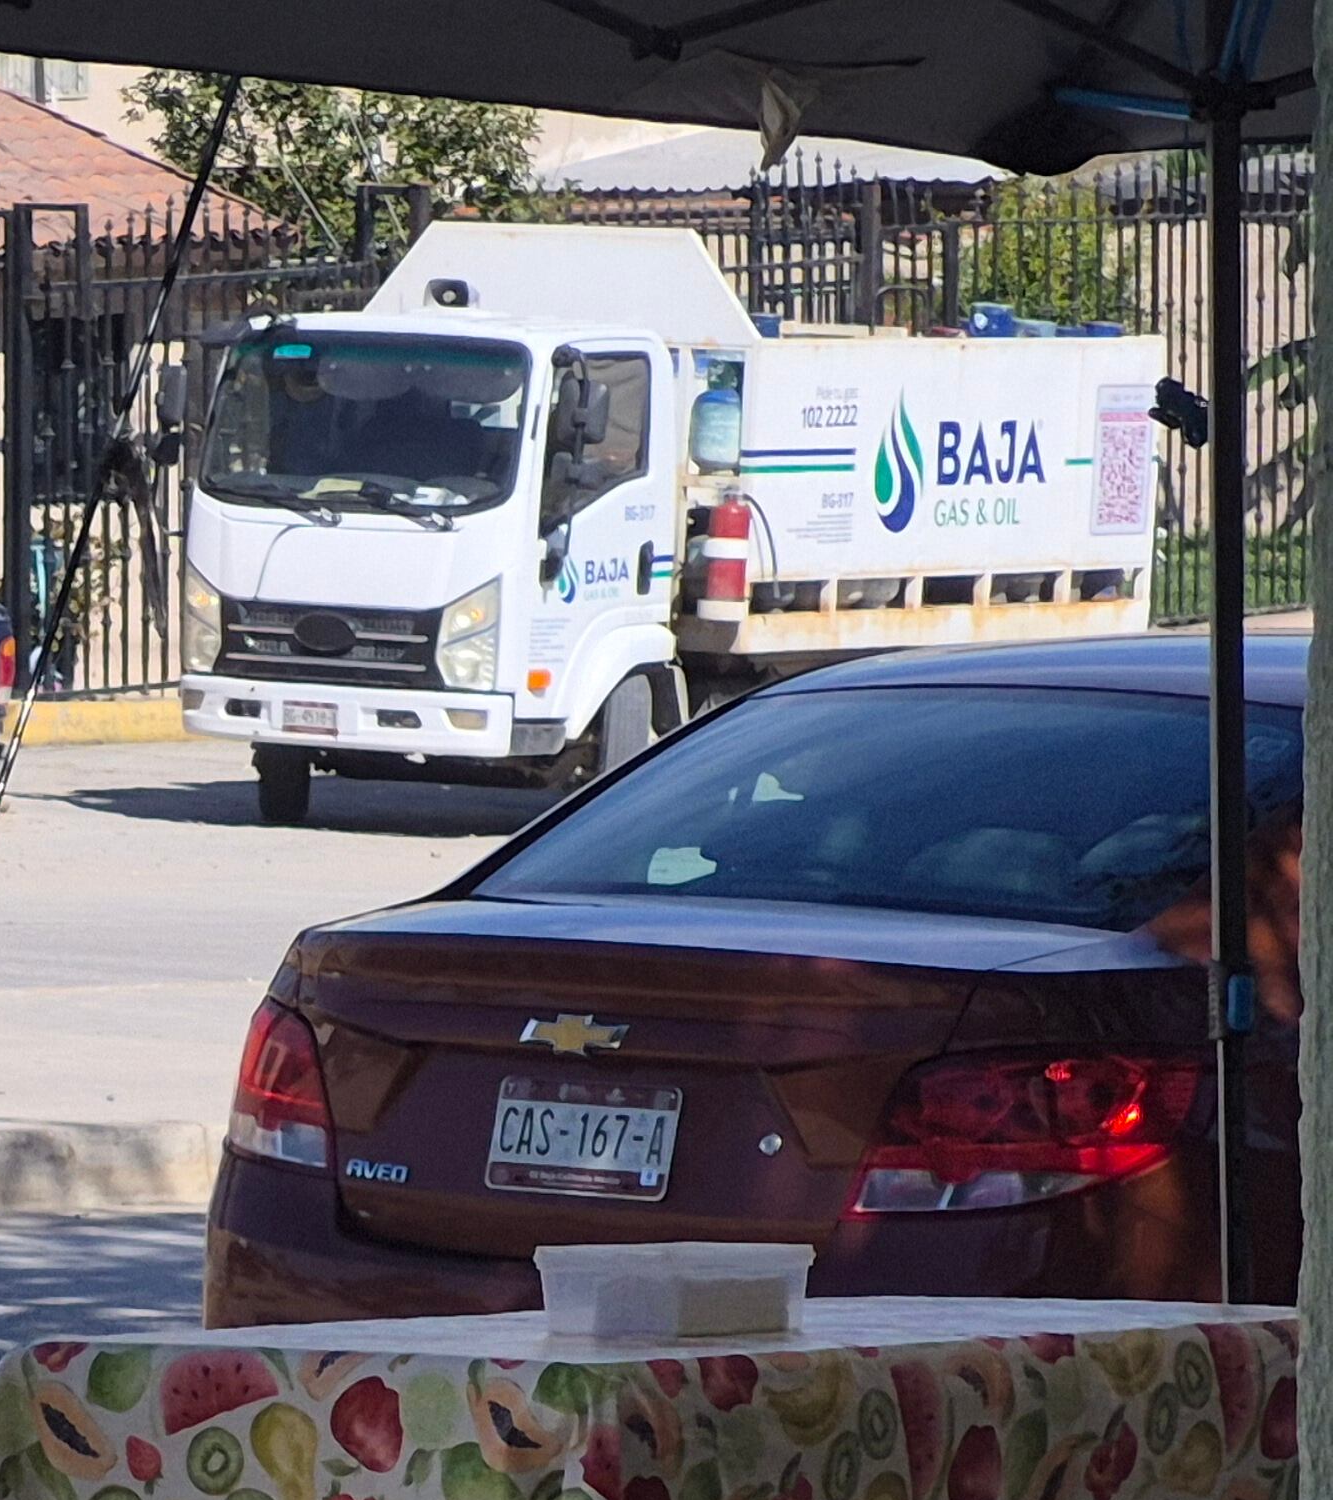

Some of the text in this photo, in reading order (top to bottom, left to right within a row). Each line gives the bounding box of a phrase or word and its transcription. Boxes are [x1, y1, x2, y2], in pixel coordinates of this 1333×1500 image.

[802, 404, 858, 429] 102 2222
[936, 419, 1046, 485] BAJA
[933, 496, 1020, 528] GAS & OIL
[584, 557, 629, 585] BAJA
[499, 1106, 667, 1166] CAS-167-A
[346, 1158, 409, 1184] AVEO
